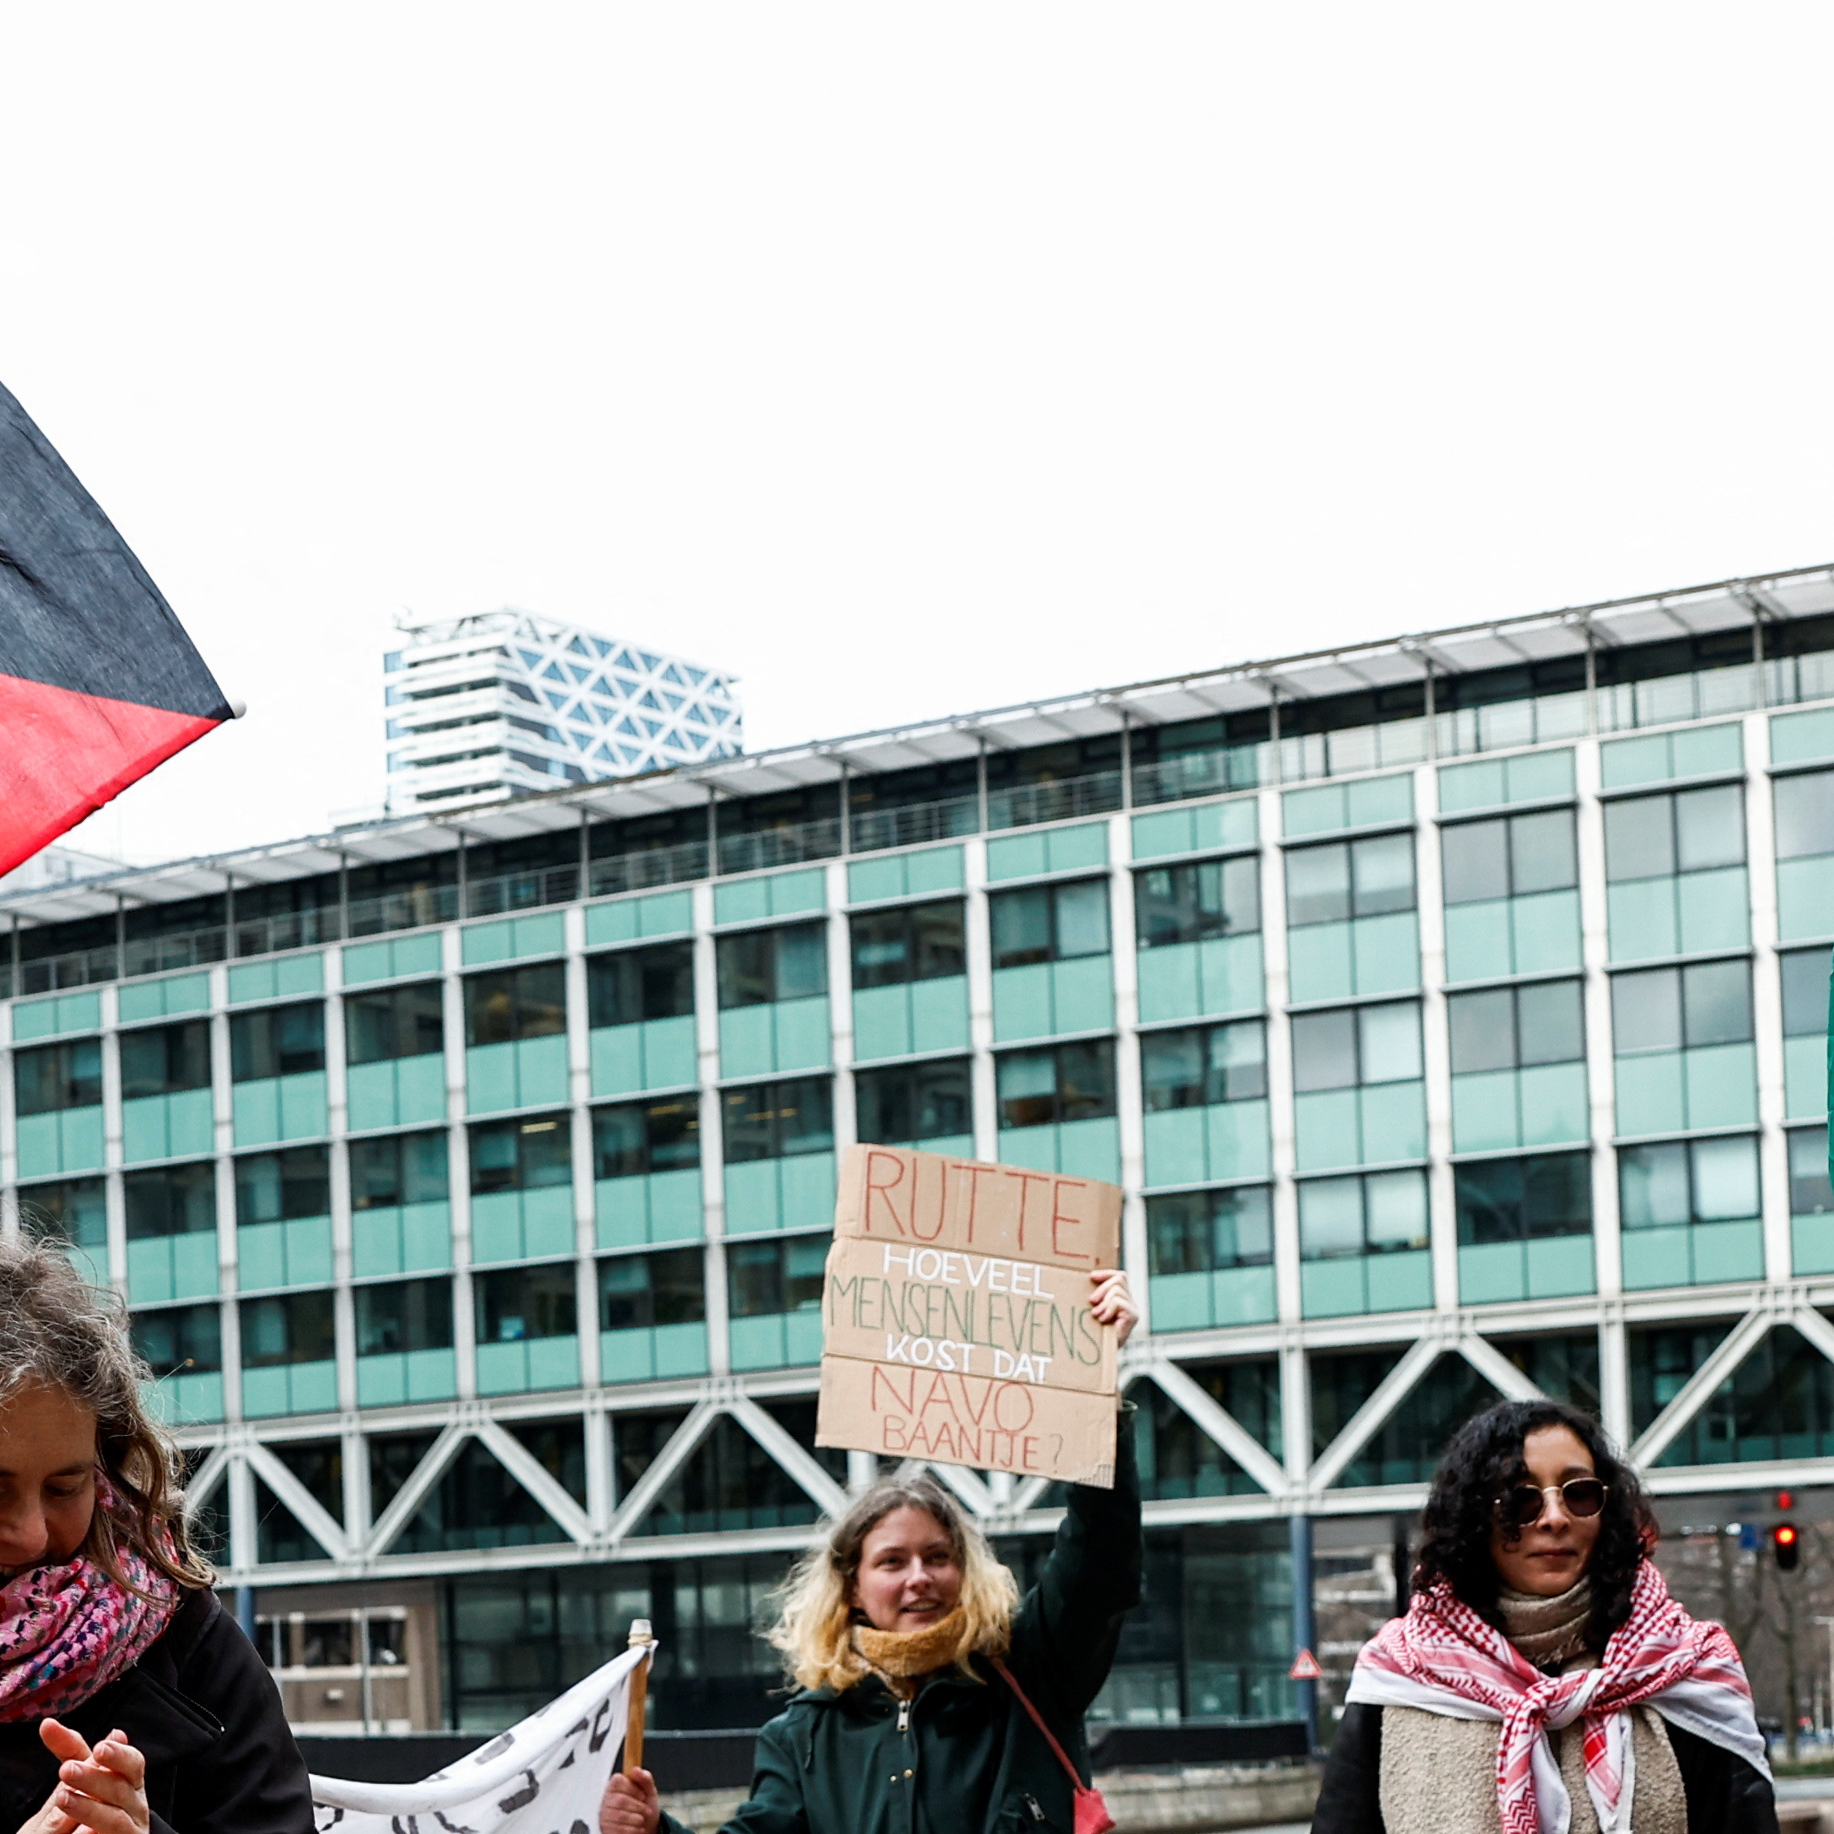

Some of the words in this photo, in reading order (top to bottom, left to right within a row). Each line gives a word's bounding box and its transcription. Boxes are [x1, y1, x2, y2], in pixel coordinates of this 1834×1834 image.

[882, 1243, 1055, 1299] HOEVEEL
[829, 1274, 1101, 1366] MENSENLEVENS
[885, 1333, 976, 1373] KOST
[993, 1350, 1053, 1384] DAT
[870, 1365, 1034, 1434] NAVO
